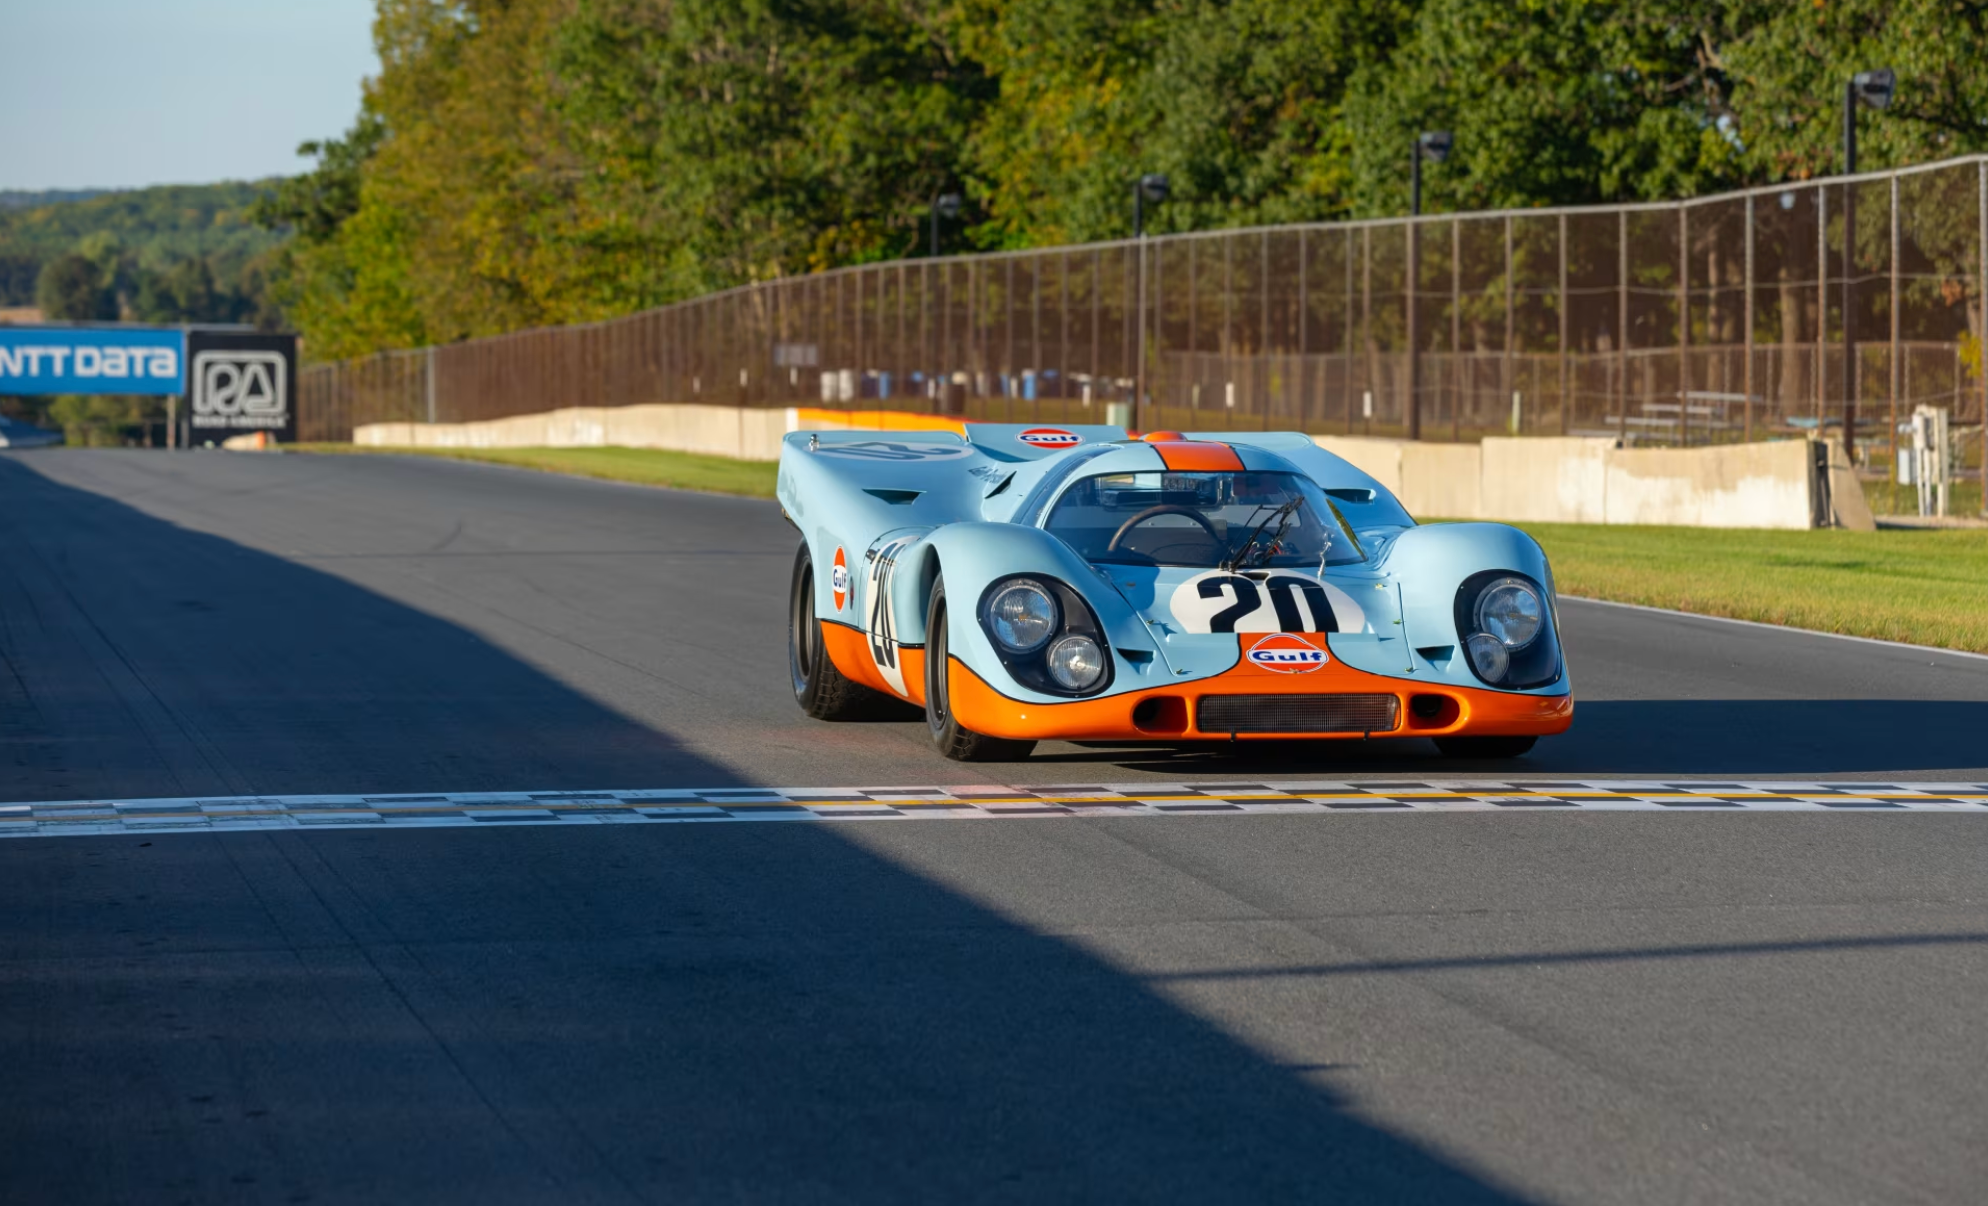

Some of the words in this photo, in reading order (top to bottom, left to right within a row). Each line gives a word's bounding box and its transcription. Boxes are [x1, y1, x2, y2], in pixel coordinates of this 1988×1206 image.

[0, 346, 70, 377] NTT
[833, 569, 847, 589] Gulf
[1196, 576, 1339, 633] 20
[1252, 651, 1322, 661] Gulf
